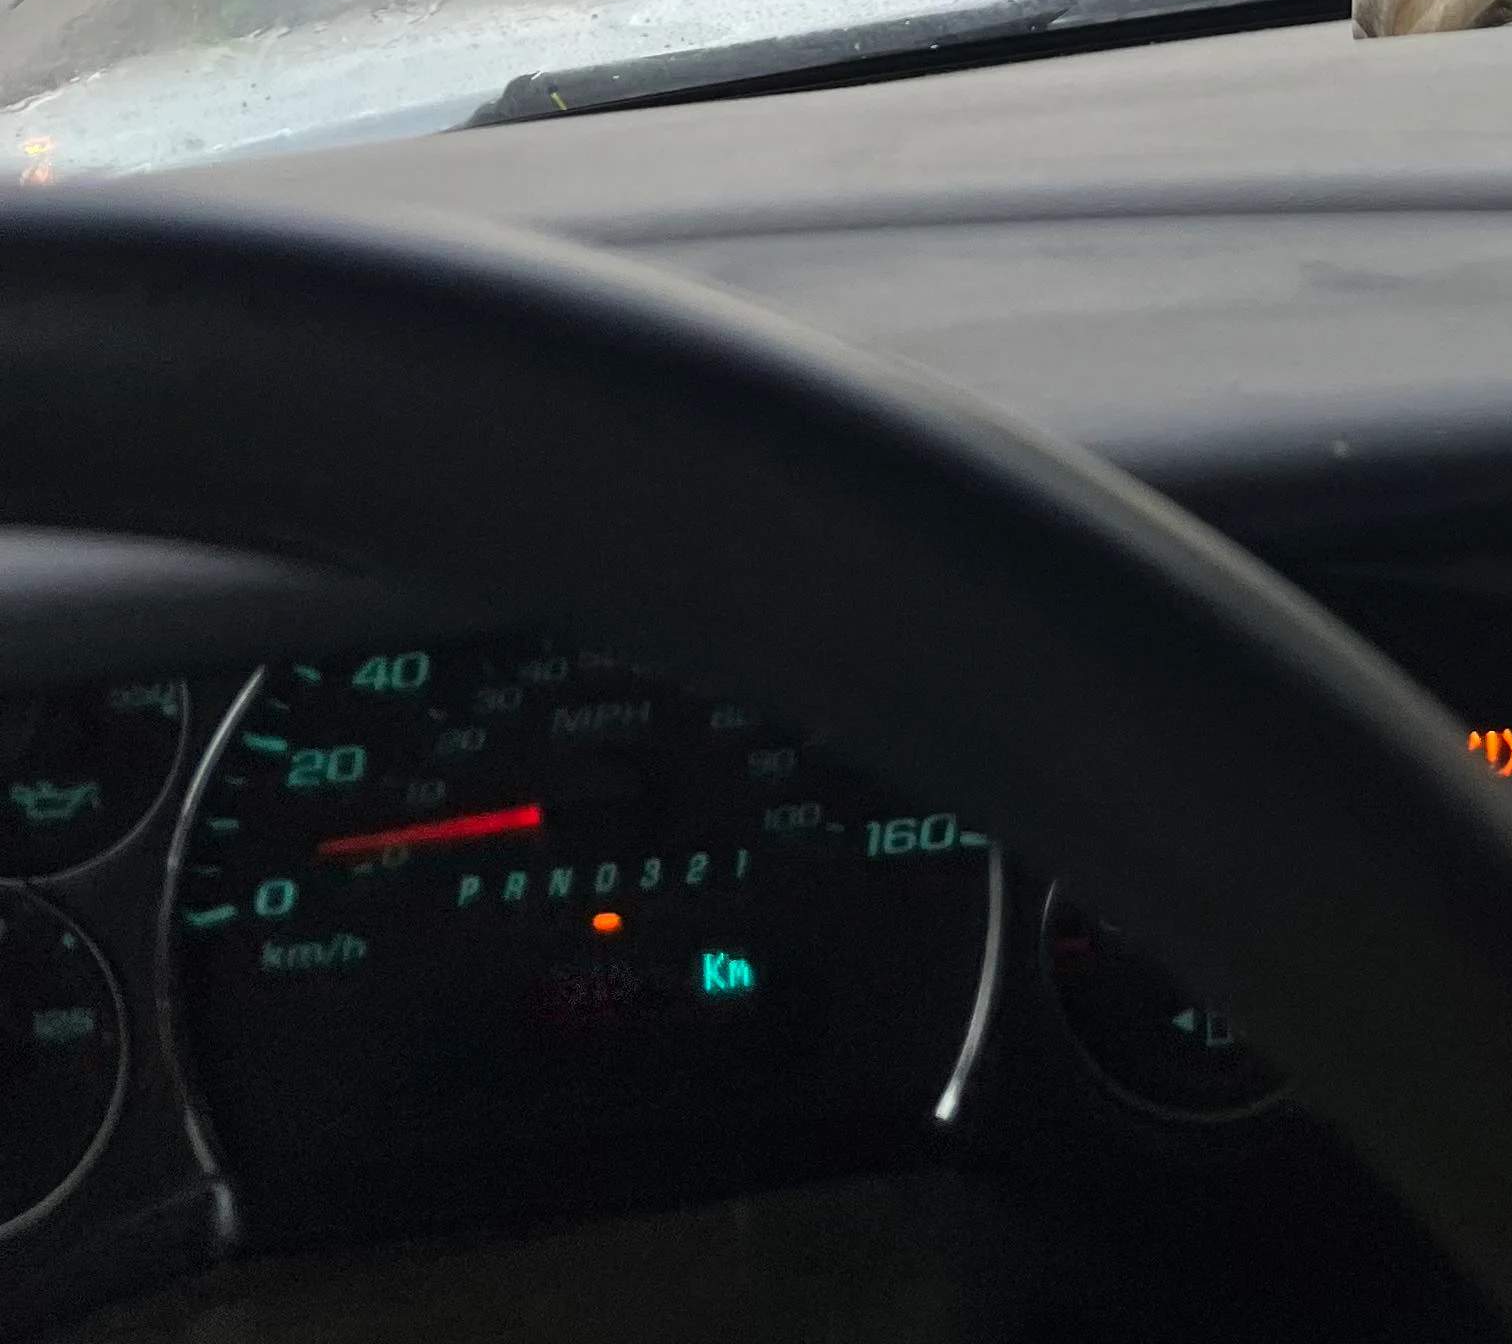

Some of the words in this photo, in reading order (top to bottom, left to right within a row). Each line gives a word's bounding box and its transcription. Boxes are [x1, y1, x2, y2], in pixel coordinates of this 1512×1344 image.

[350, 651, 430, 691] 40
[551, 700, 652, 734] MPH
[287, 745, 367, 788] 20
[864, 811, 957, 860] 160
[254, 877, 298, 918] 0
[261, 933, 367, 973] km/h
